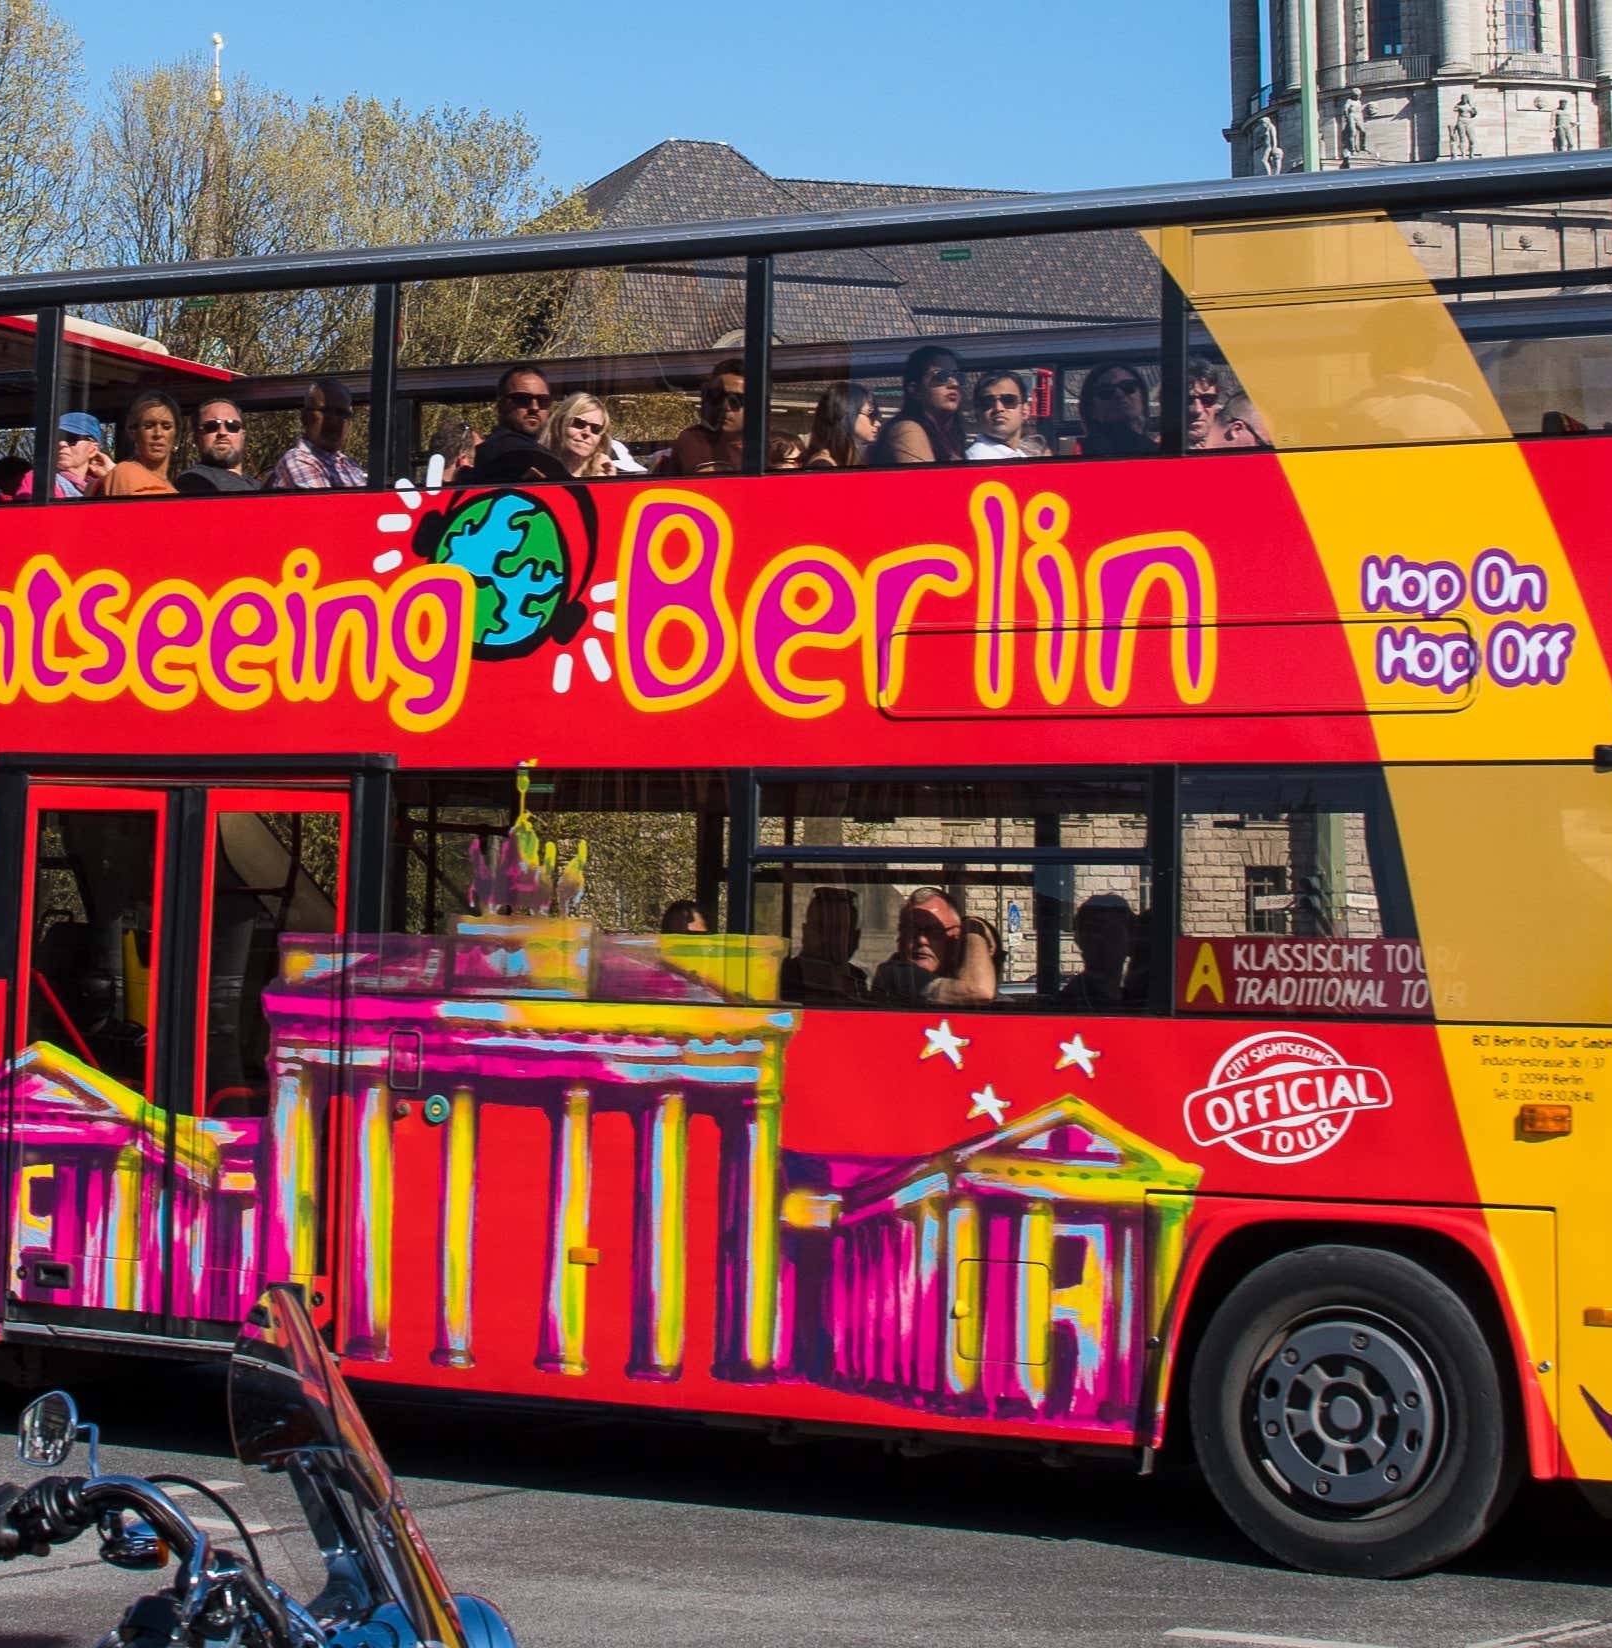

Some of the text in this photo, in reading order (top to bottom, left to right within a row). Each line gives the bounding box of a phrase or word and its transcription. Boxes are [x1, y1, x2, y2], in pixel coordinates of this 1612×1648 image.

[615, 480, 1217, 719] Berlin
[1361, 548, 1548, 620] Hop On
[1376, 620, 1576, 694] Hop Off
[1185, 942, 1224, 1003] A
[1232, 943, 1374, 973] KLASSISCHE
[1235, 976, 1388, 1008] TRADITIONAL
[1225, 1041, 1334, 1081] CITY SIGHTSEEING
[1493, 1035, 1526, 1047] Berlin
[1529, 1036, 1550, 1049] City
[1553, 1036, 1579, 1049] Tour
[1205, 1073, 1379, 1132] OFFICIAL
[1552, 1073, 1585, 1085] Berlin
[1260, 1117, 1338, 1153] TOUR
